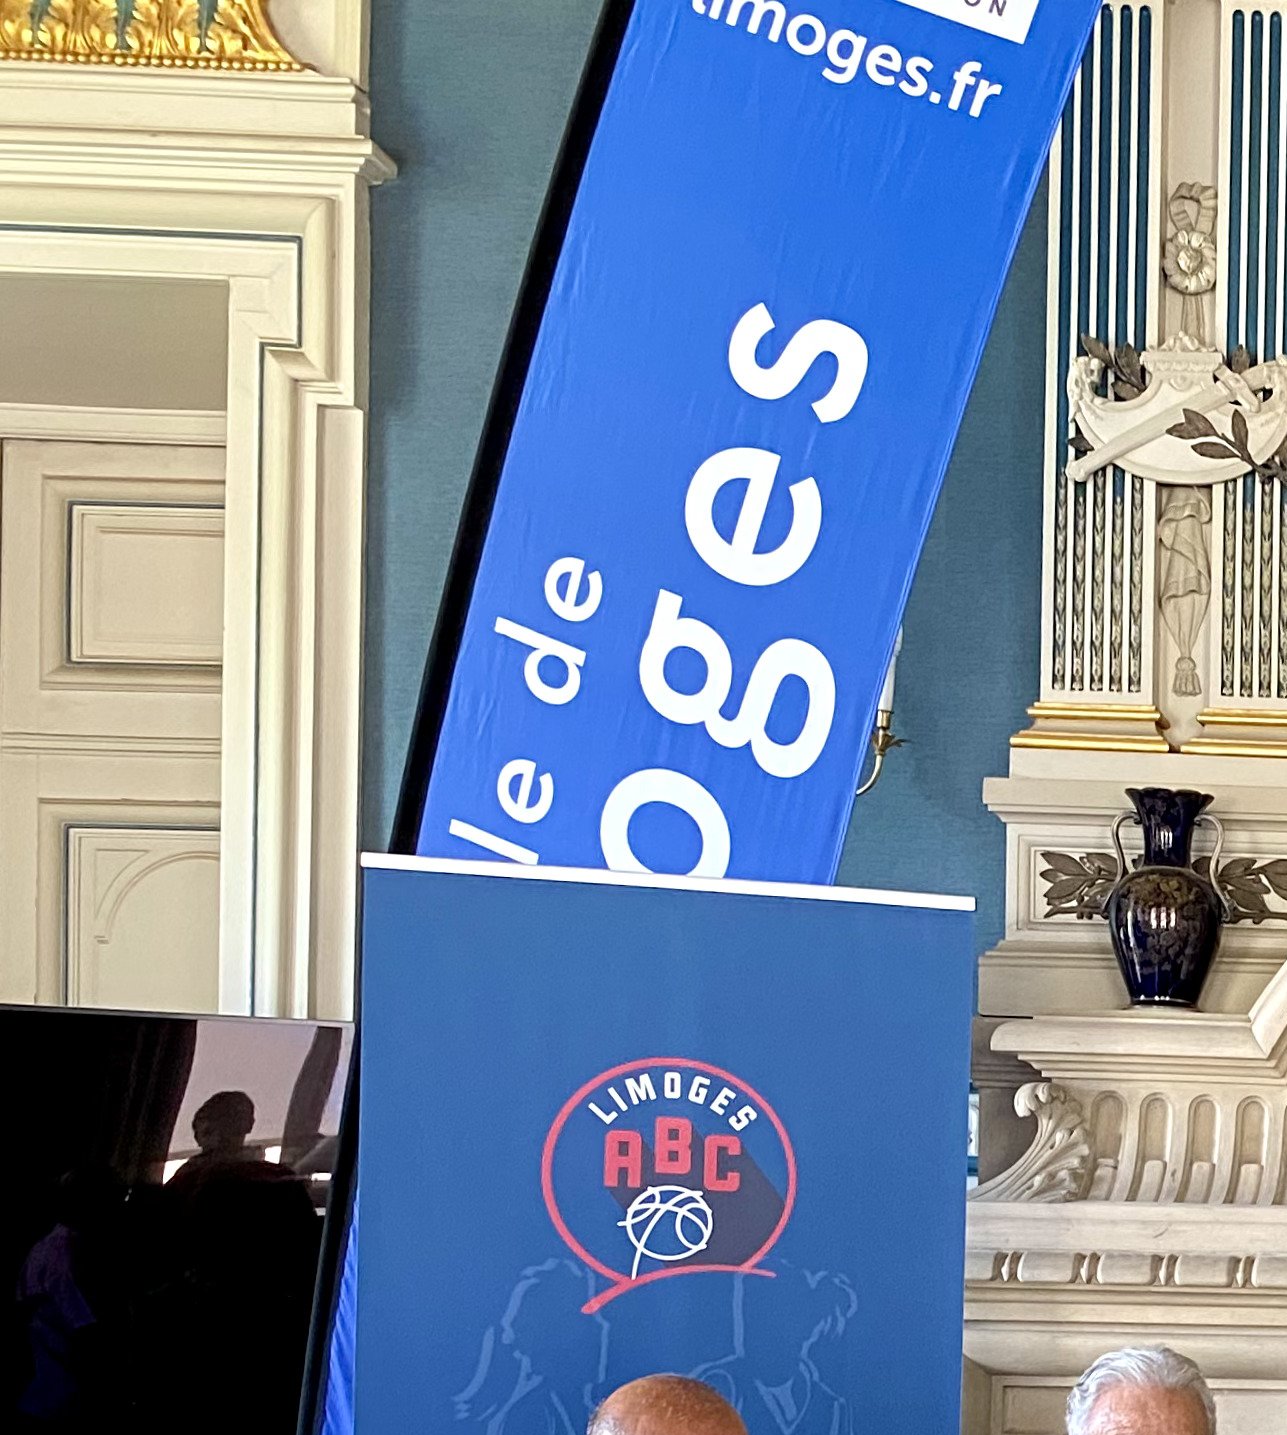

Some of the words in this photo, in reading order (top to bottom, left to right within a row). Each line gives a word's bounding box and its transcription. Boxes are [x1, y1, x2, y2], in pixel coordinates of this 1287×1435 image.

[691, 0, 1002, 118] moges.fr
[494, 556, 603, 705] de
[600, 302, 869, 878] oges
[588, 1071, 758, 1132] LIMOGES
[603, 1116, 742, 1192] ABC
